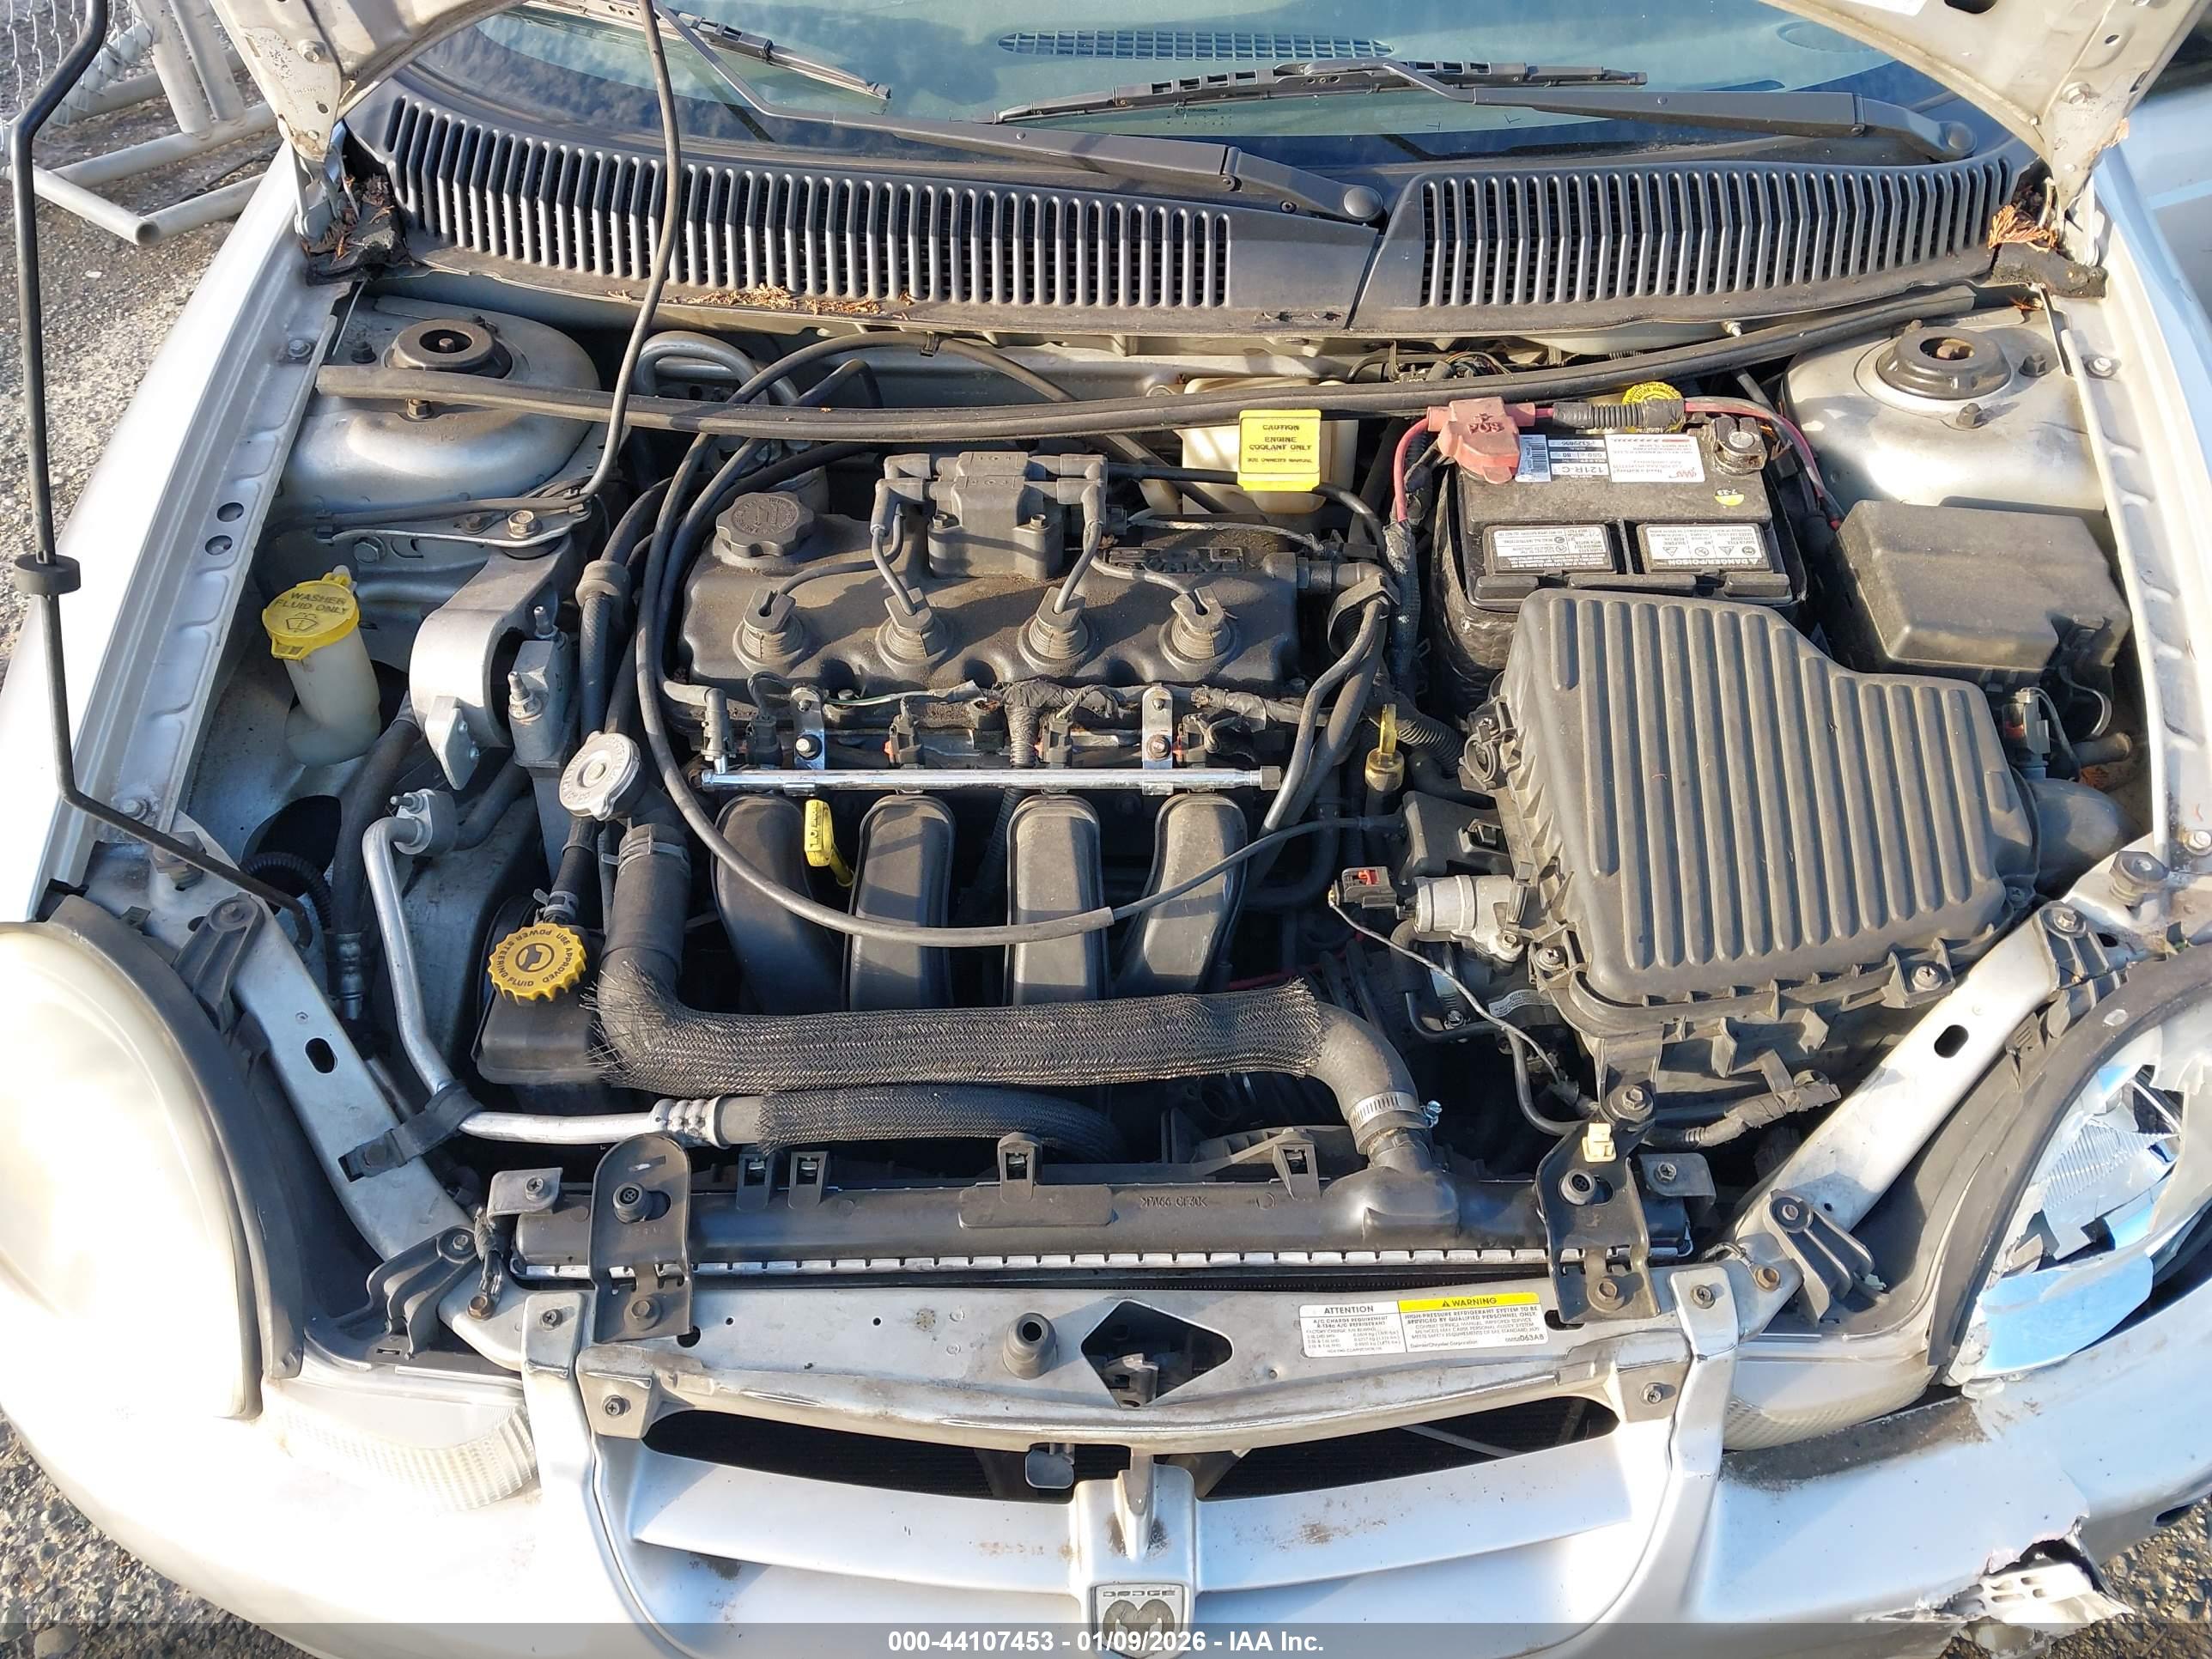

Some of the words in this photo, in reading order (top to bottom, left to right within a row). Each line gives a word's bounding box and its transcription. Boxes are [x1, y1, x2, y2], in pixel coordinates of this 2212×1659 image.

[291, 592, 346, 605] WASHER
[274, 599, 312, 610] FLUID
[316, 605, 350, 615] ONLY
[515, 929, 553, 941] POWER
[556, 933, 570, 945] USE
[496, 941, 514, 979] STEERING
[542, 947, 574, 983] APPROVED
[507, 976, 534, 987] FLUID
[1451, 1297, 1497, 1306] WARNING
[1323, 1305, 1373, 1314] ATTENTION
